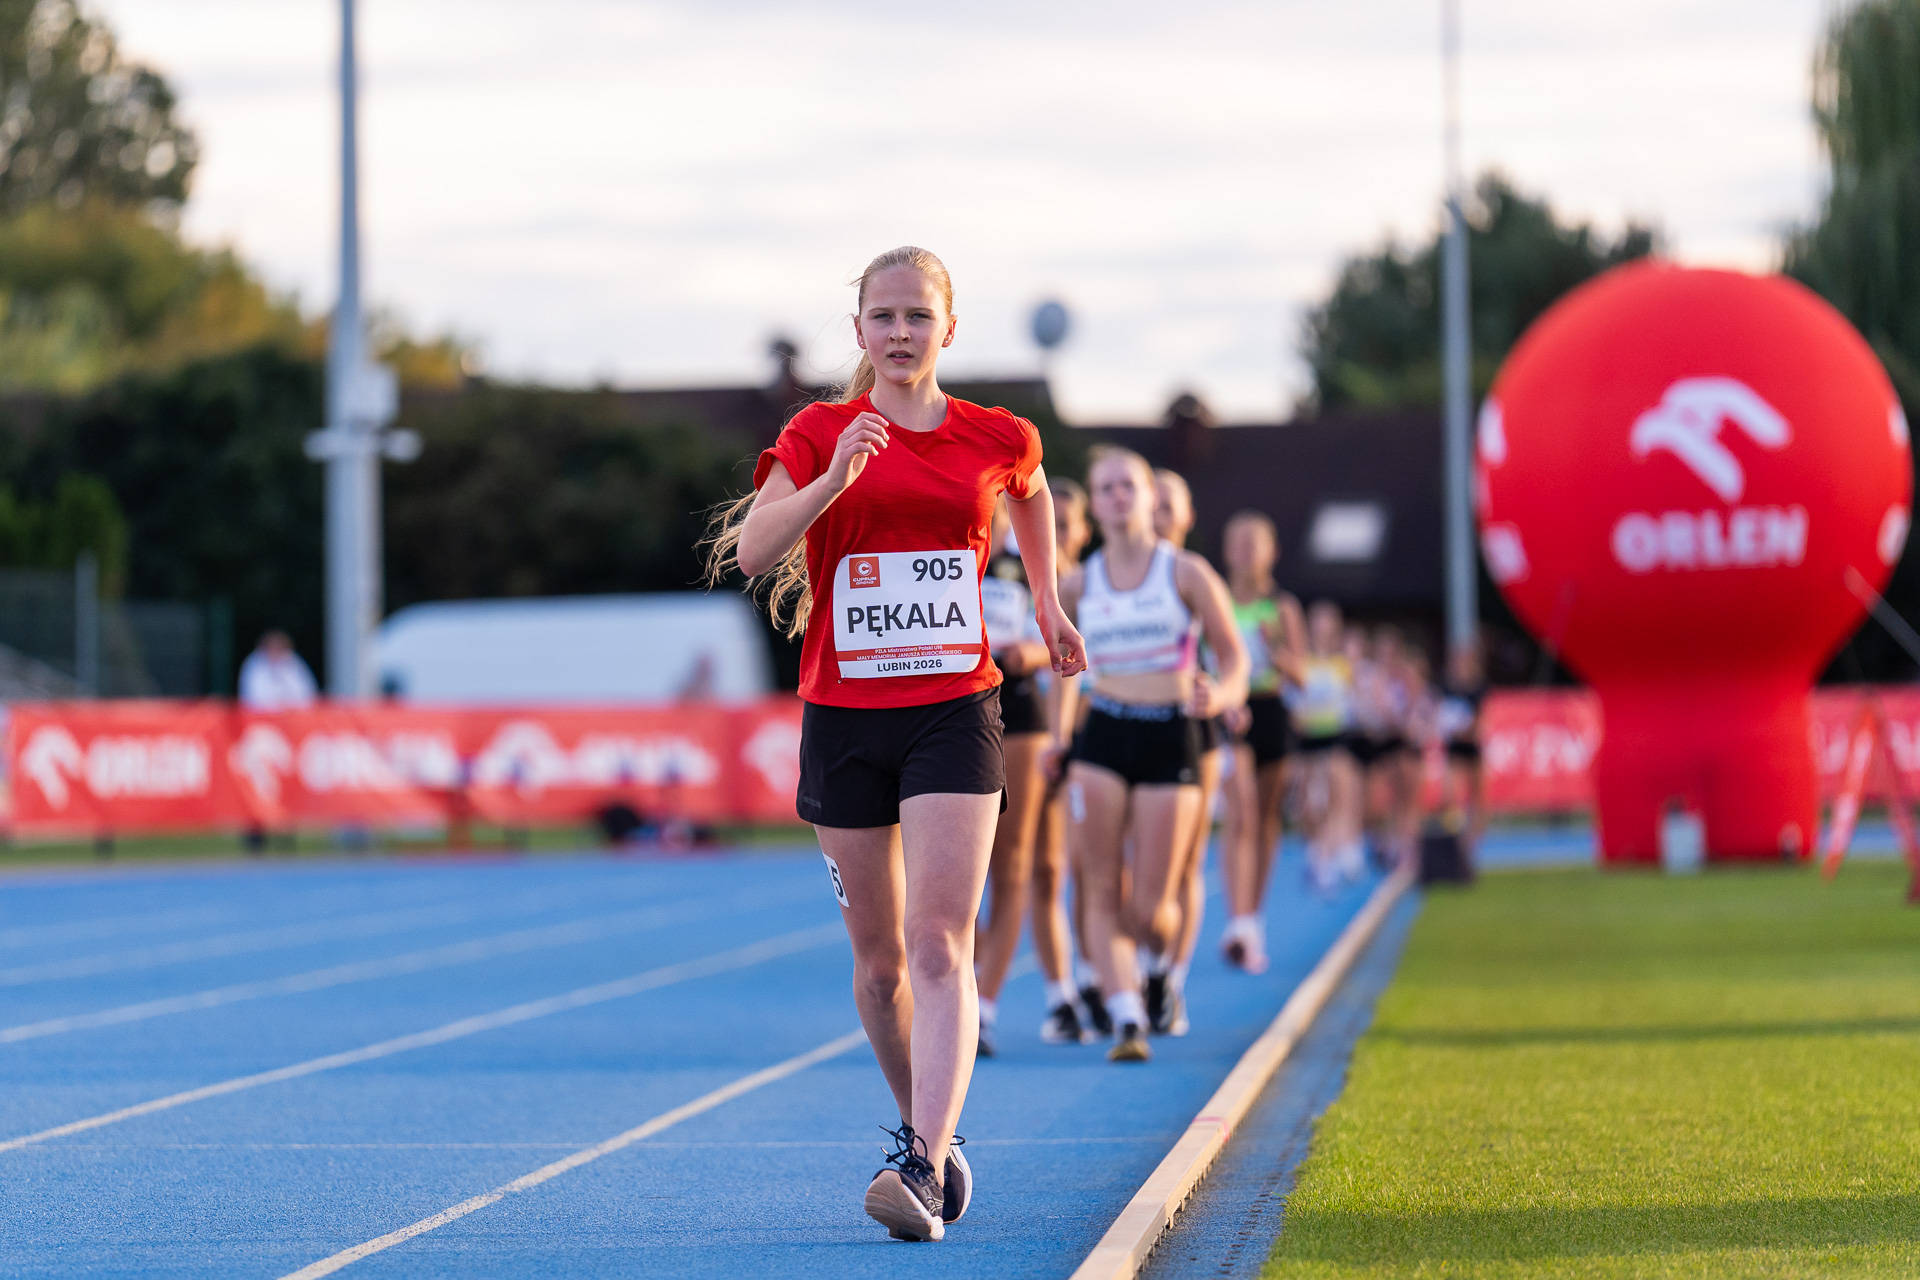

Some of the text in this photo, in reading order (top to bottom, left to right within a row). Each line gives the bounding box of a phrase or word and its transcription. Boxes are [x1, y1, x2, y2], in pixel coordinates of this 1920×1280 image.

[1609, 505, 1808, 574] ORLEN
[912, 557, 963, 582] 905
[847, 601, 967, 637] PĘKALA
[877, 659, 943, 672] LUBIN 2026
